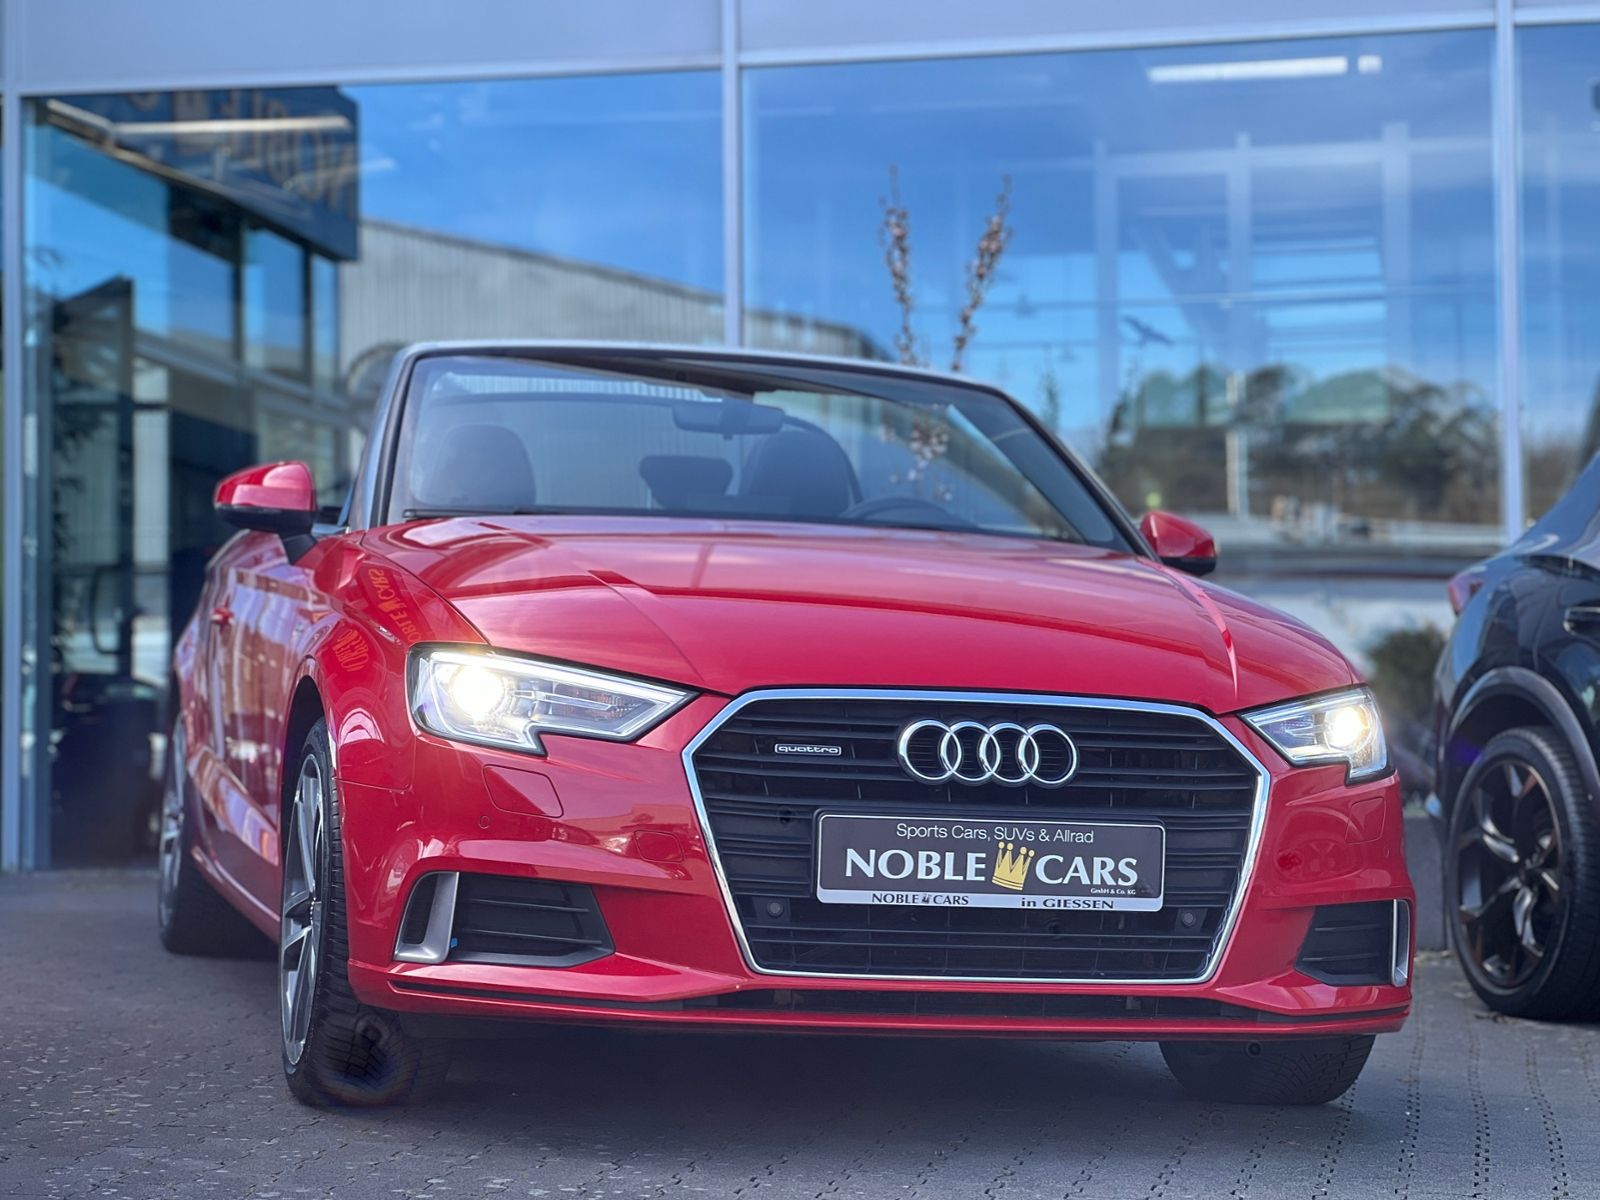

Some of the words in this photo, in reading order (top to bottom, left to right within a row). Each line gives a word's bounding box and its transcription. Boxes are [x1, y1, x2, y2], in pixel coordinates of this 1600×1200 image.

[896, 823, 948, 839] Sports
[951, 825, 991, 841] Cars,
[994, 827, 1035, 841] SUVs
[1038, 829, 1050, 841] &
[1053, 829, 1094, 843] Allrad
[845, 848, 987, 881] NOBLE
[1035, 854, 1138, 886] CARS
[872, 893, 919, 904] NOBLE
[933, 895, 969, 905] CARS
[1021, 898, 1037, 907] in
[1043, 899, 1114, 909] GIESSEN
